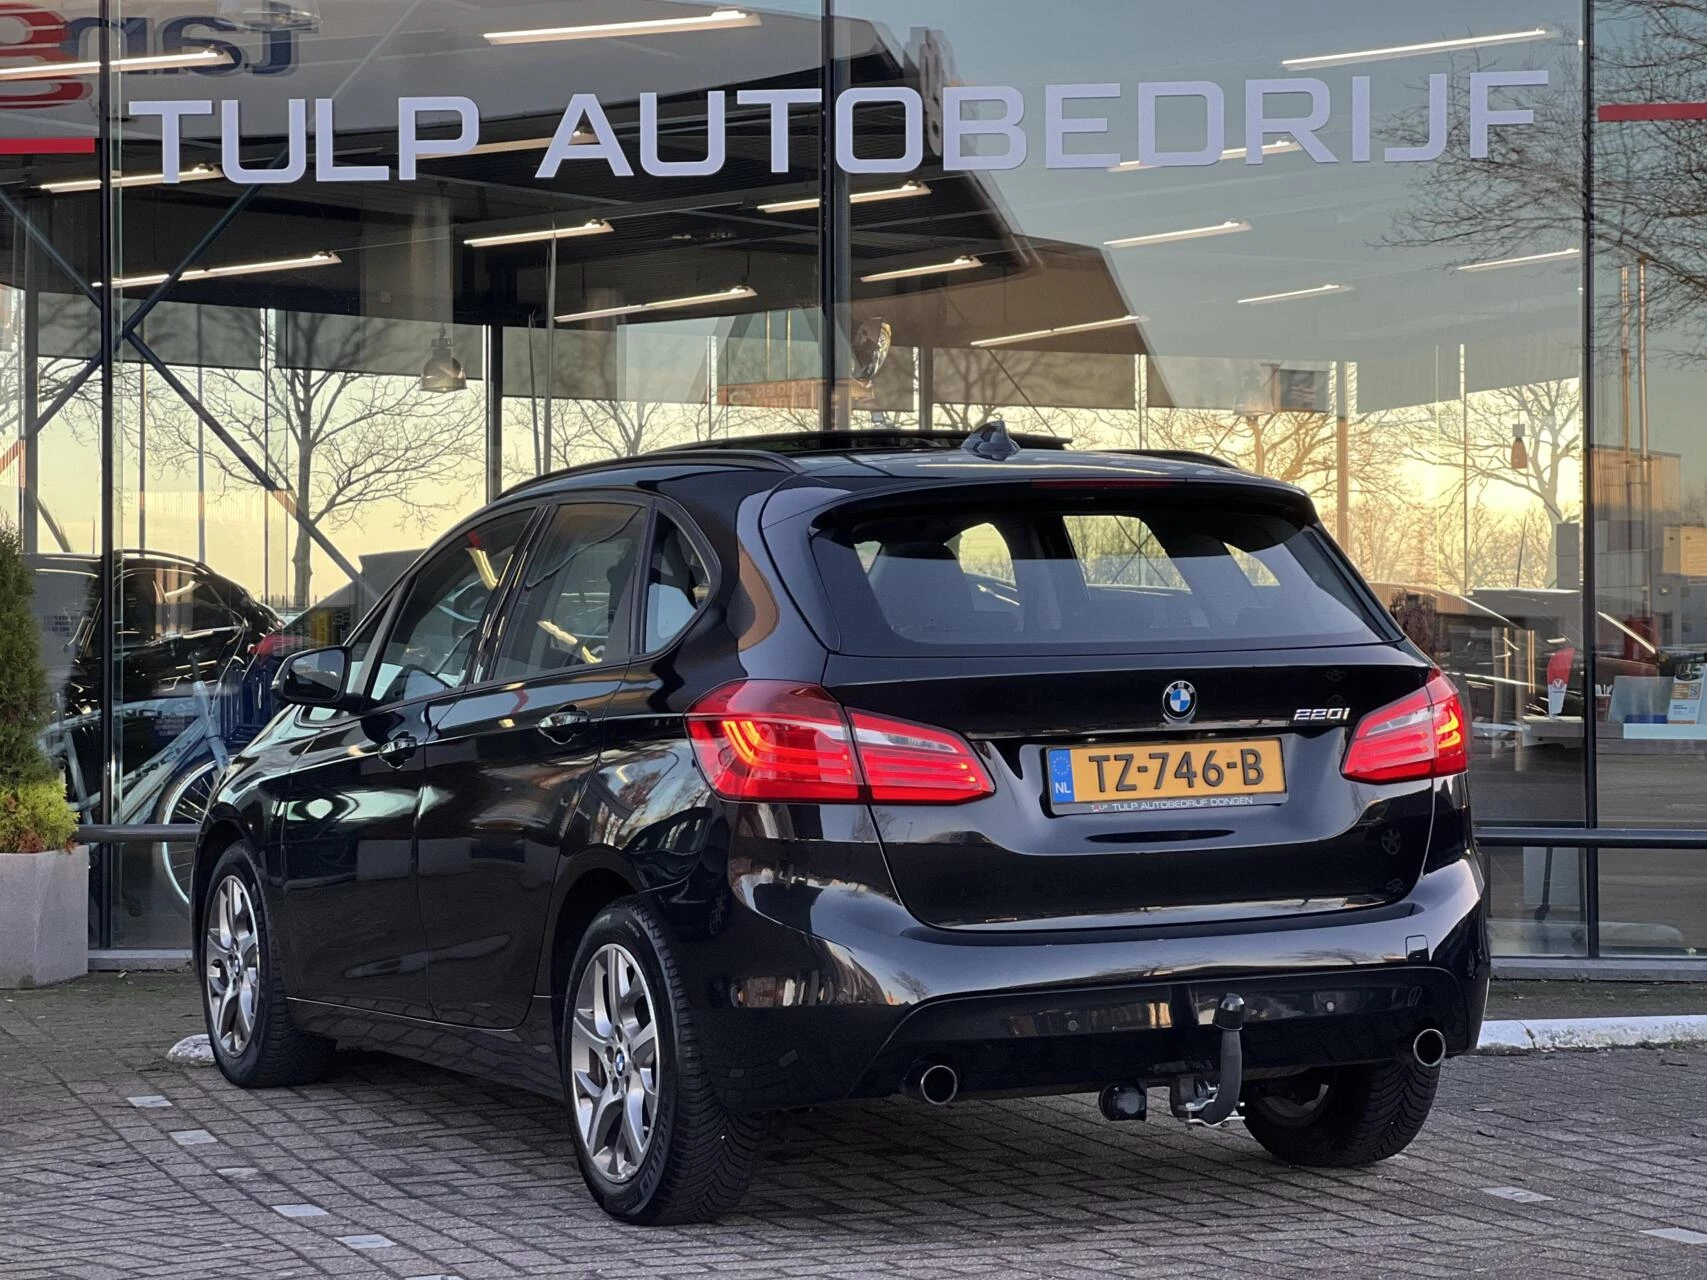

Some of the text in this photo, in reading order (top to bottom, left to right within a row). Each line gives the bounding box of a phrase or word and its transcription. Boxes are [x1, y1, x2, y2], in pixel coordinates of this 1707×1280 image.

[128, 70, 1550, 184] TULP AUTOBEDRIJF
[1055, 748, 1264, 794] NL TZ-746-B
[1112, 802, 1138, 811] TULP
[1140, 799, 1208, 810] AUTOBEDRIJF
[1210, 797, 1253, 807] DONGEN
